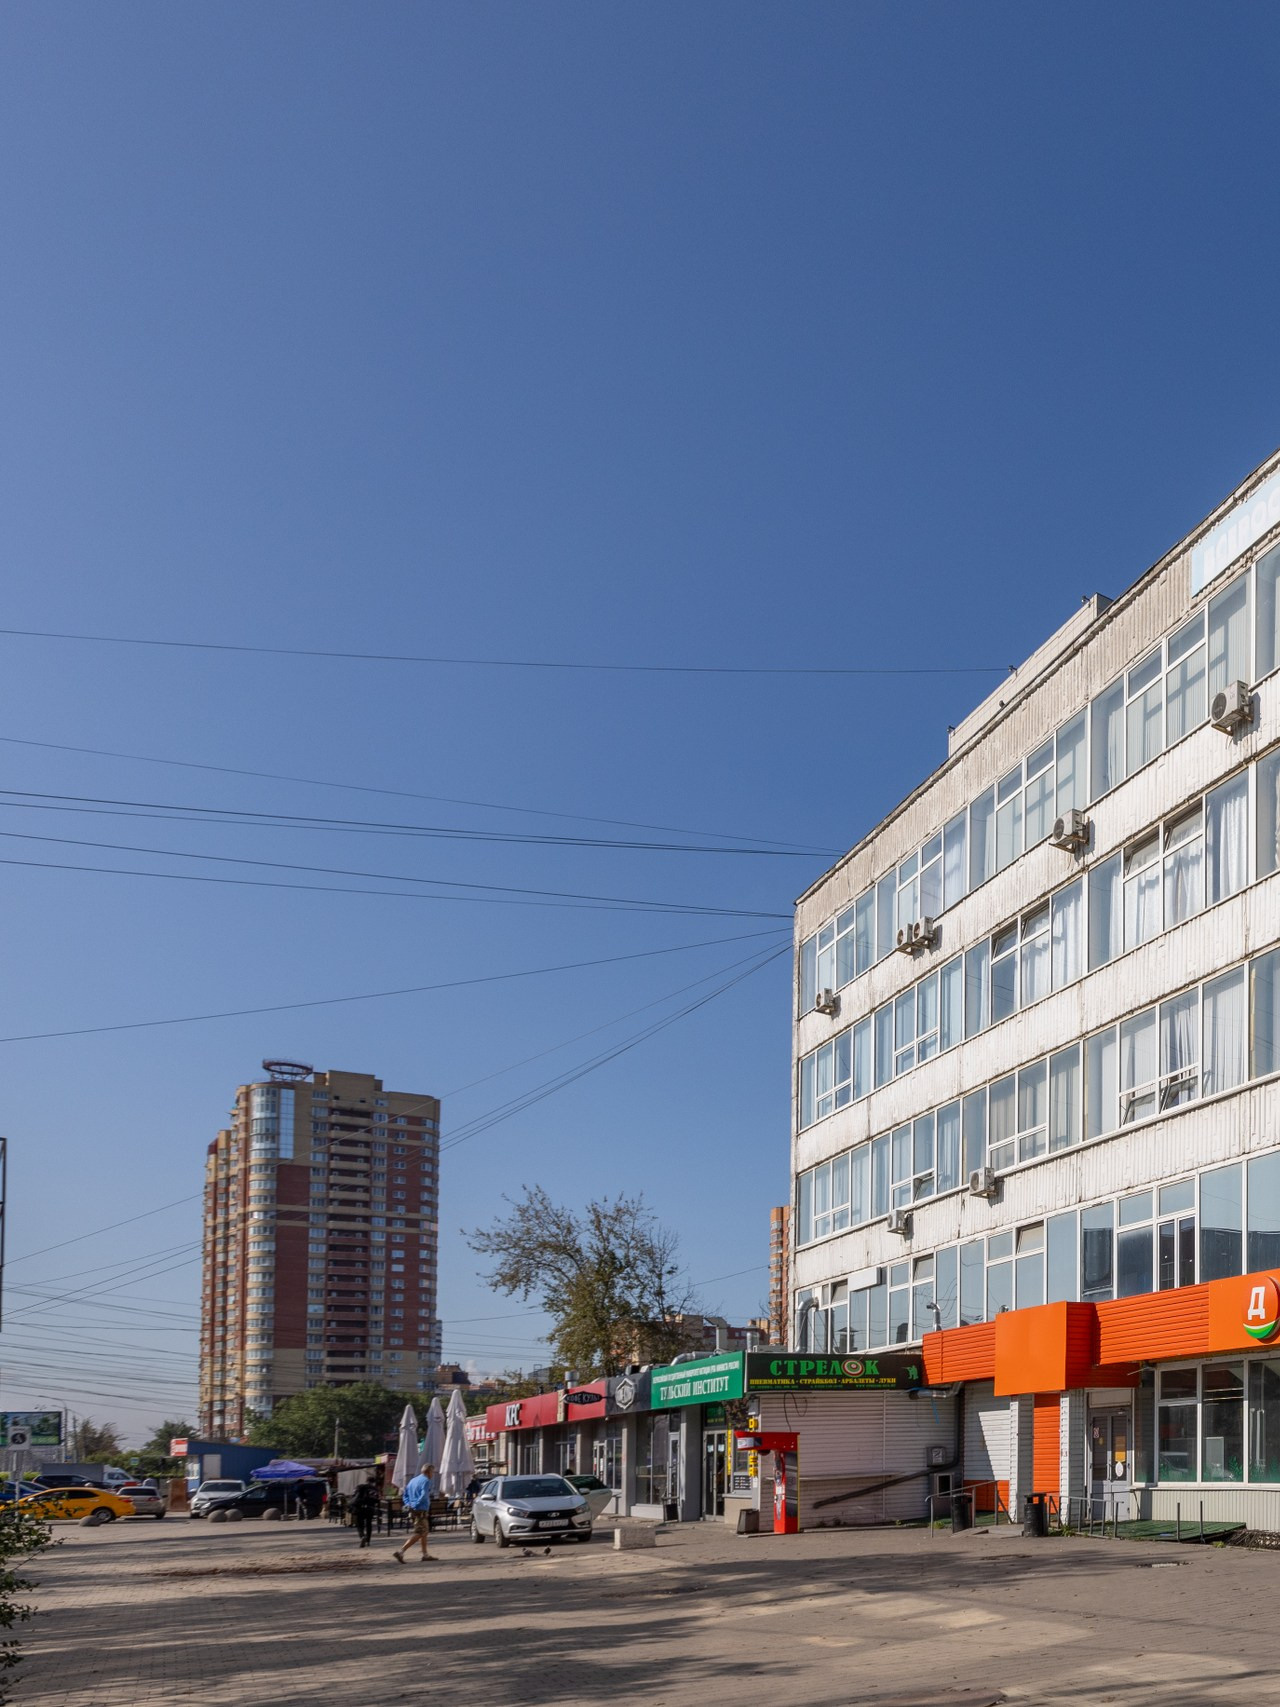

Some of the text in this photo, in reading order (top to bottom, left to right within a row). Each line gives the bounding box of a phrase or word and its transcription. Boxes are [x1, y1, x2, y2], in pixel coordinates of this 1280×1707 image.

[1247, 1286, 1267, 1320] Д
[660, 1376, 729, 1400] ТУЛЬСКИЙ ИНСТИТУТ
[505, 1404, 520, 1427] KFC
